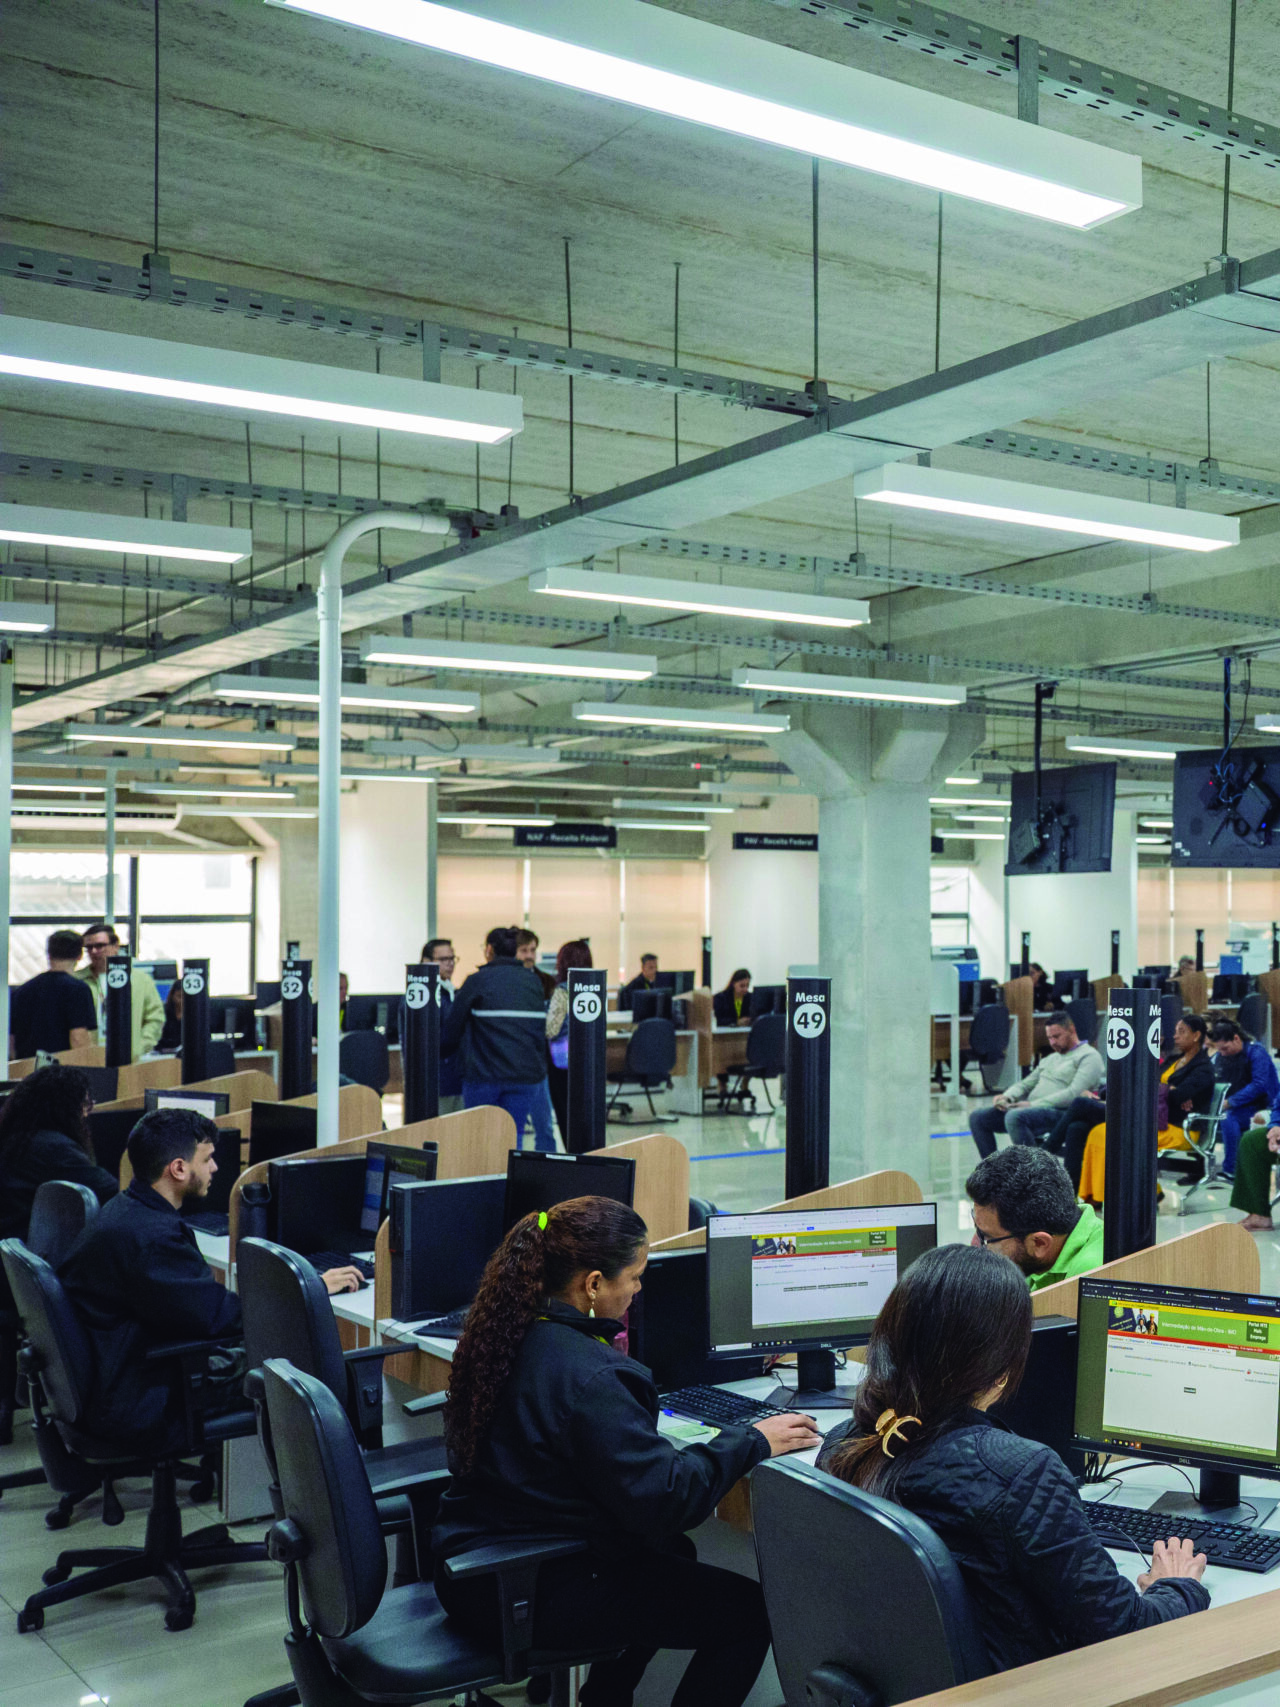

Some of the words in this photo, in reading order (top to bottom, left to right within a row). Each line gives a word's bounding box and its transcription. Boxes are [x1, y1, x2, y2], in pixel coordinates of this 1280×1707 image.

[551, 833, 579, 842] Receita
[581, 833, 609, 843] Federal
[763, 837, 788, 845] Receita
[789, 838, 814, 846] Federal
[110, 974, 125, 983] 54
[185, 979, 201, 989] 53
[284, 982, 299, 993] 52
[573, 983, 601, 992] Mesa
[408, 989, 424, 1001] 51
[795, 992, 825, 1002] Mesa
[577, 1000, 597, 1014] 50
[797, 1012, 823, 1029] 49
[1108, 1028, 1129, 1049] 48
[1178, 1457, 1191, 1465] DELL
